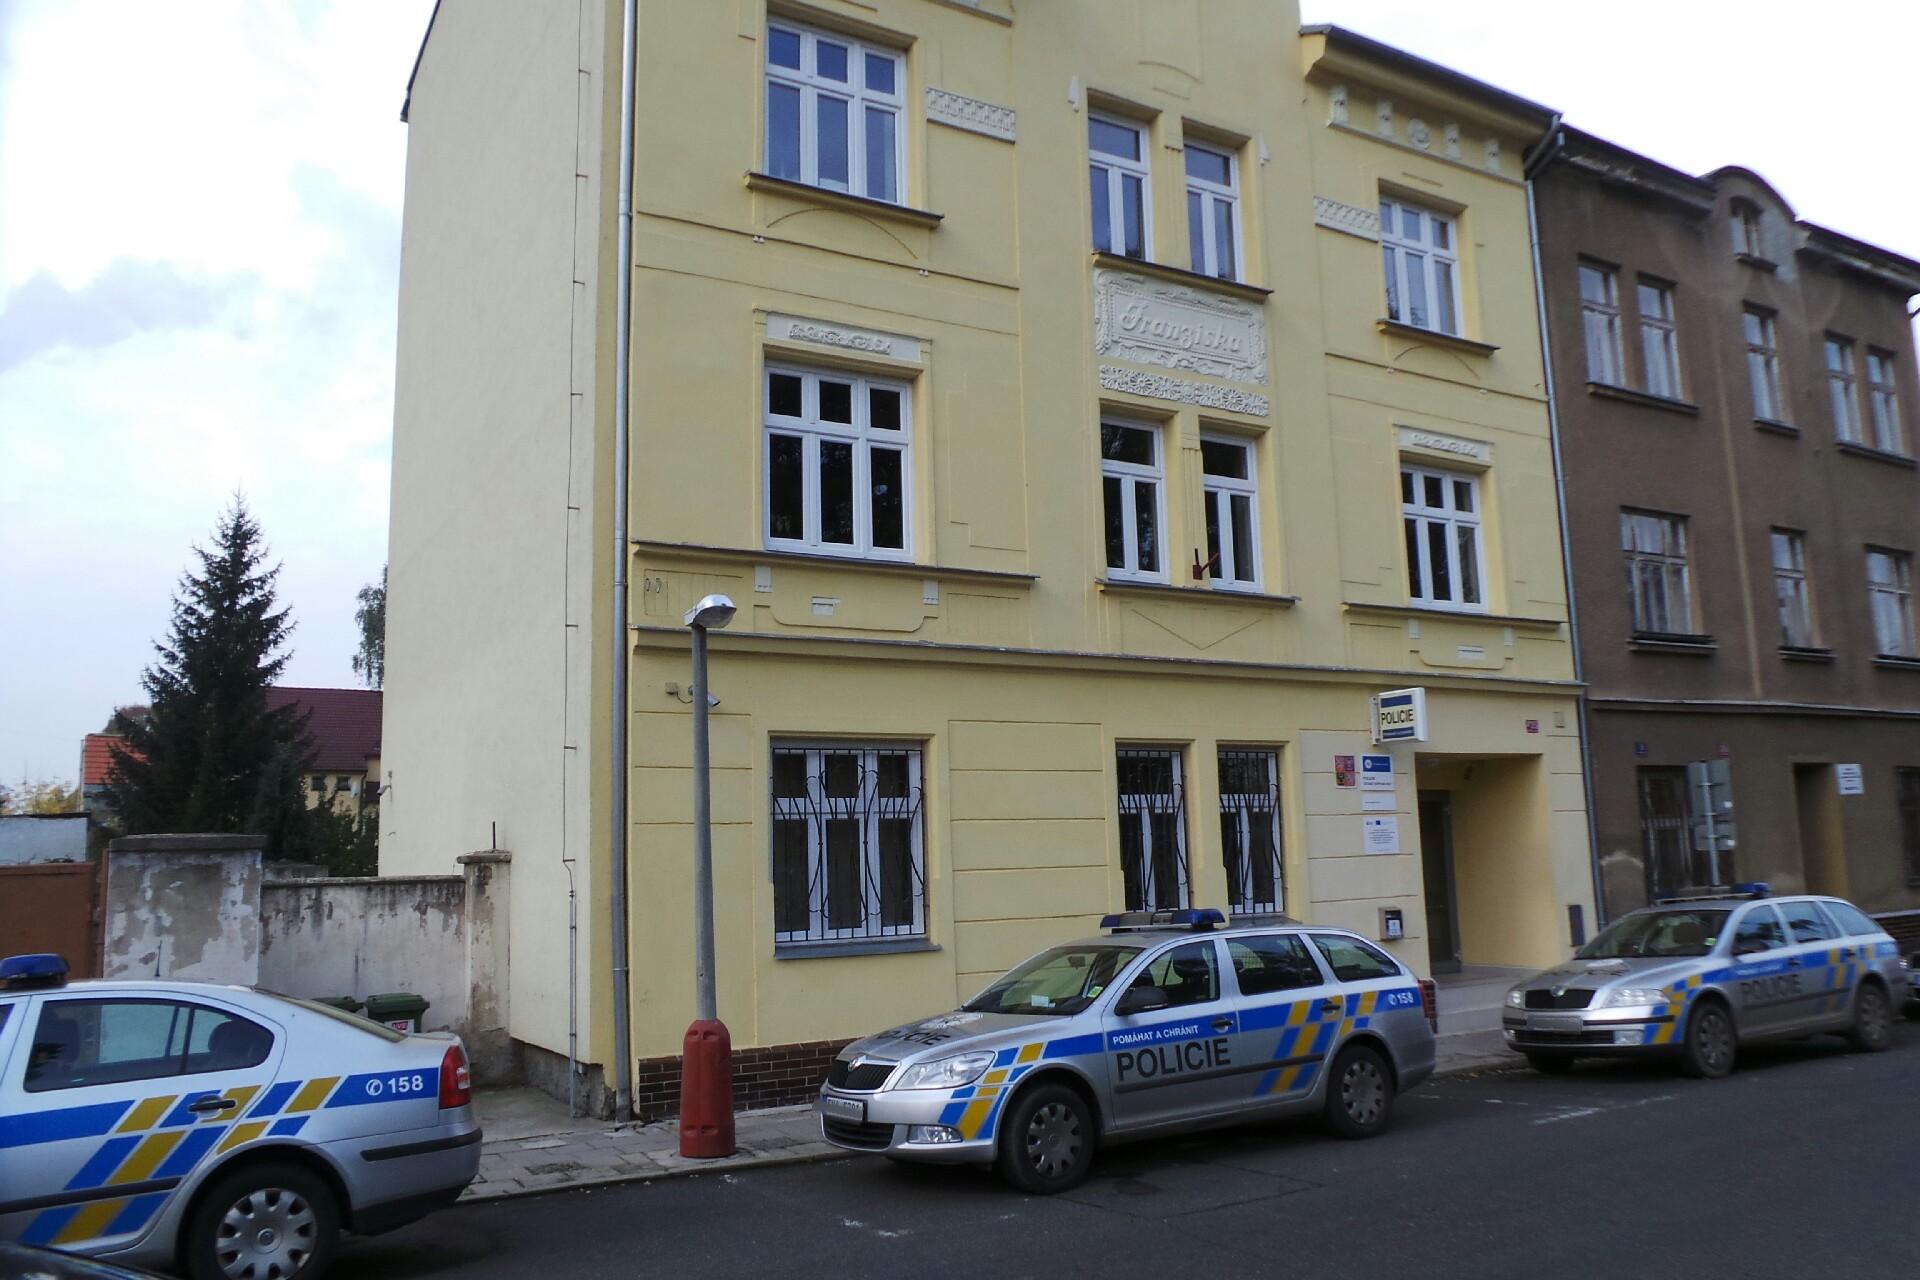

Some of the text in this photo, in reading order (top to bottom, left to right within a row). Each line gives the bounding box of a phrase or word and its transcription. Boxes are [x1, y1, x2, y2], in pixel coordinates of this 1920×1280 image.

[1381, 708, 1414, 726] POLICIE
[1397, 992, 1414, 1004] 158
[1112, 1025, 1199, 1045] POMÁHAT A CHRÁNIT
[1115, 1038, 1231, 1081] POLICIE
[387, 1075, 424, 1094] 158
